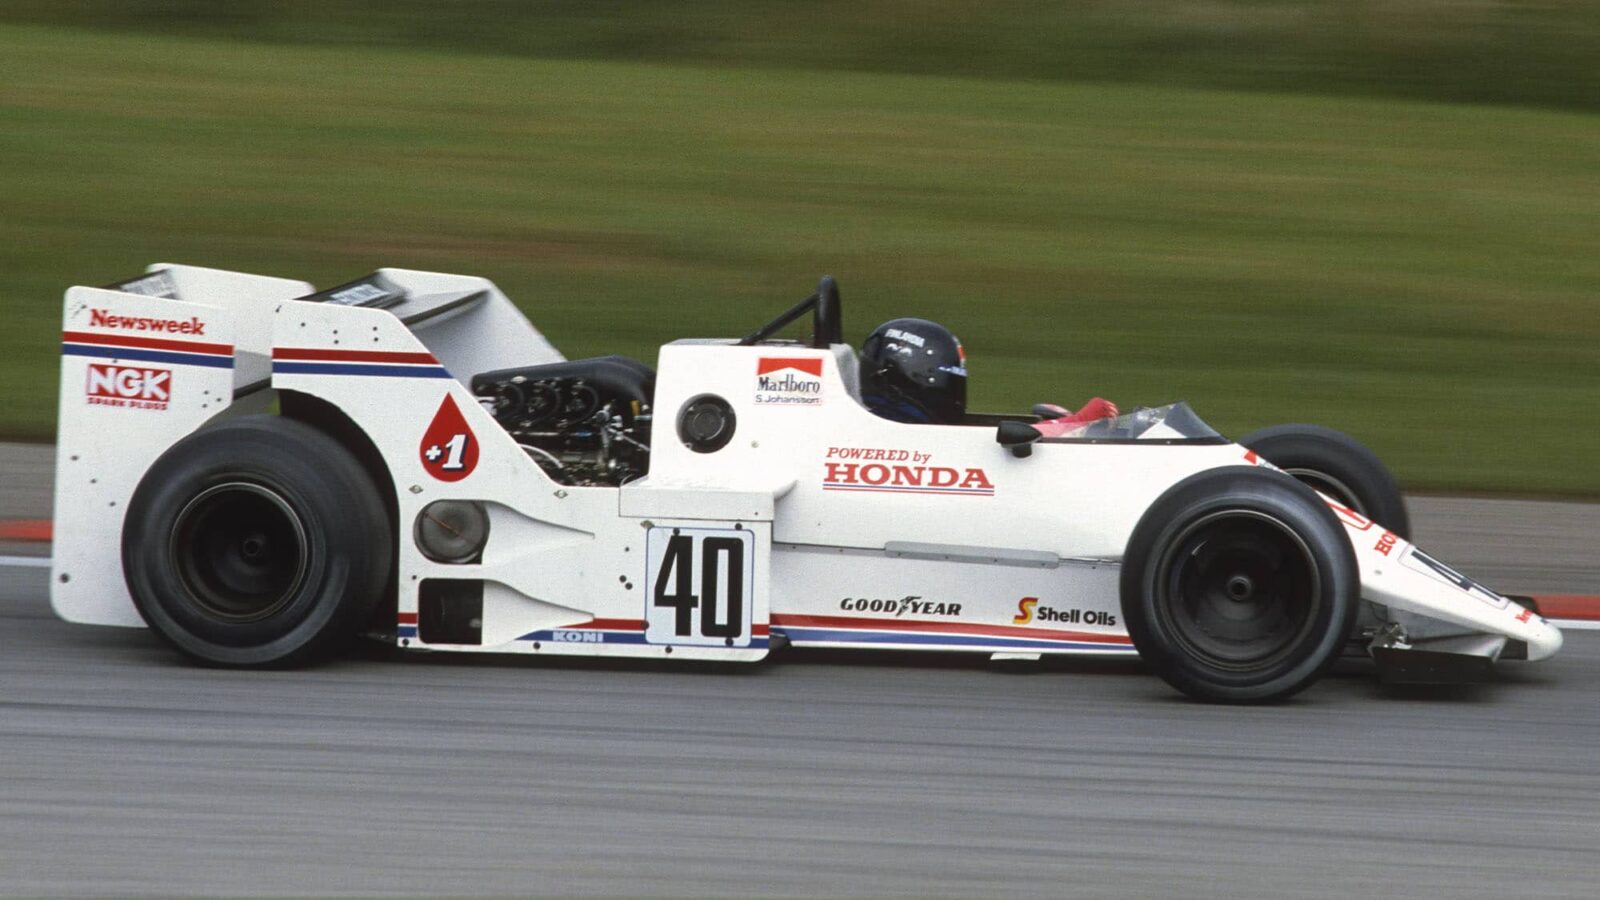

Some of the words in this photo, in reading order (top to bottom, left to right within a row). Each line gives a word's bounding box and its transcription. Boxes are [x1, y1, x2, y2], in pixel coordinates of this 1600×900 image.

[89, 308, 206, 335] Newsweek
[89, 366, 169, 400] NGK
[757, 374, 820, 394] Marlboro
[764, 395, 820, 404] Johansson
[425, 434, 468, 472] +1
[826, 447, 909, 461] POWERED
[912, 450, 931, 464] by
[823, 463, 995, 489] HONDA
[654, 535, 744, 638] 40
[840, 596, 962, 616] GOODYEAR
[1037, 606, 1081, 624] Shell
[1083, 610, 1116, 626] Oils
[552, 631, 604, 642] KONI
